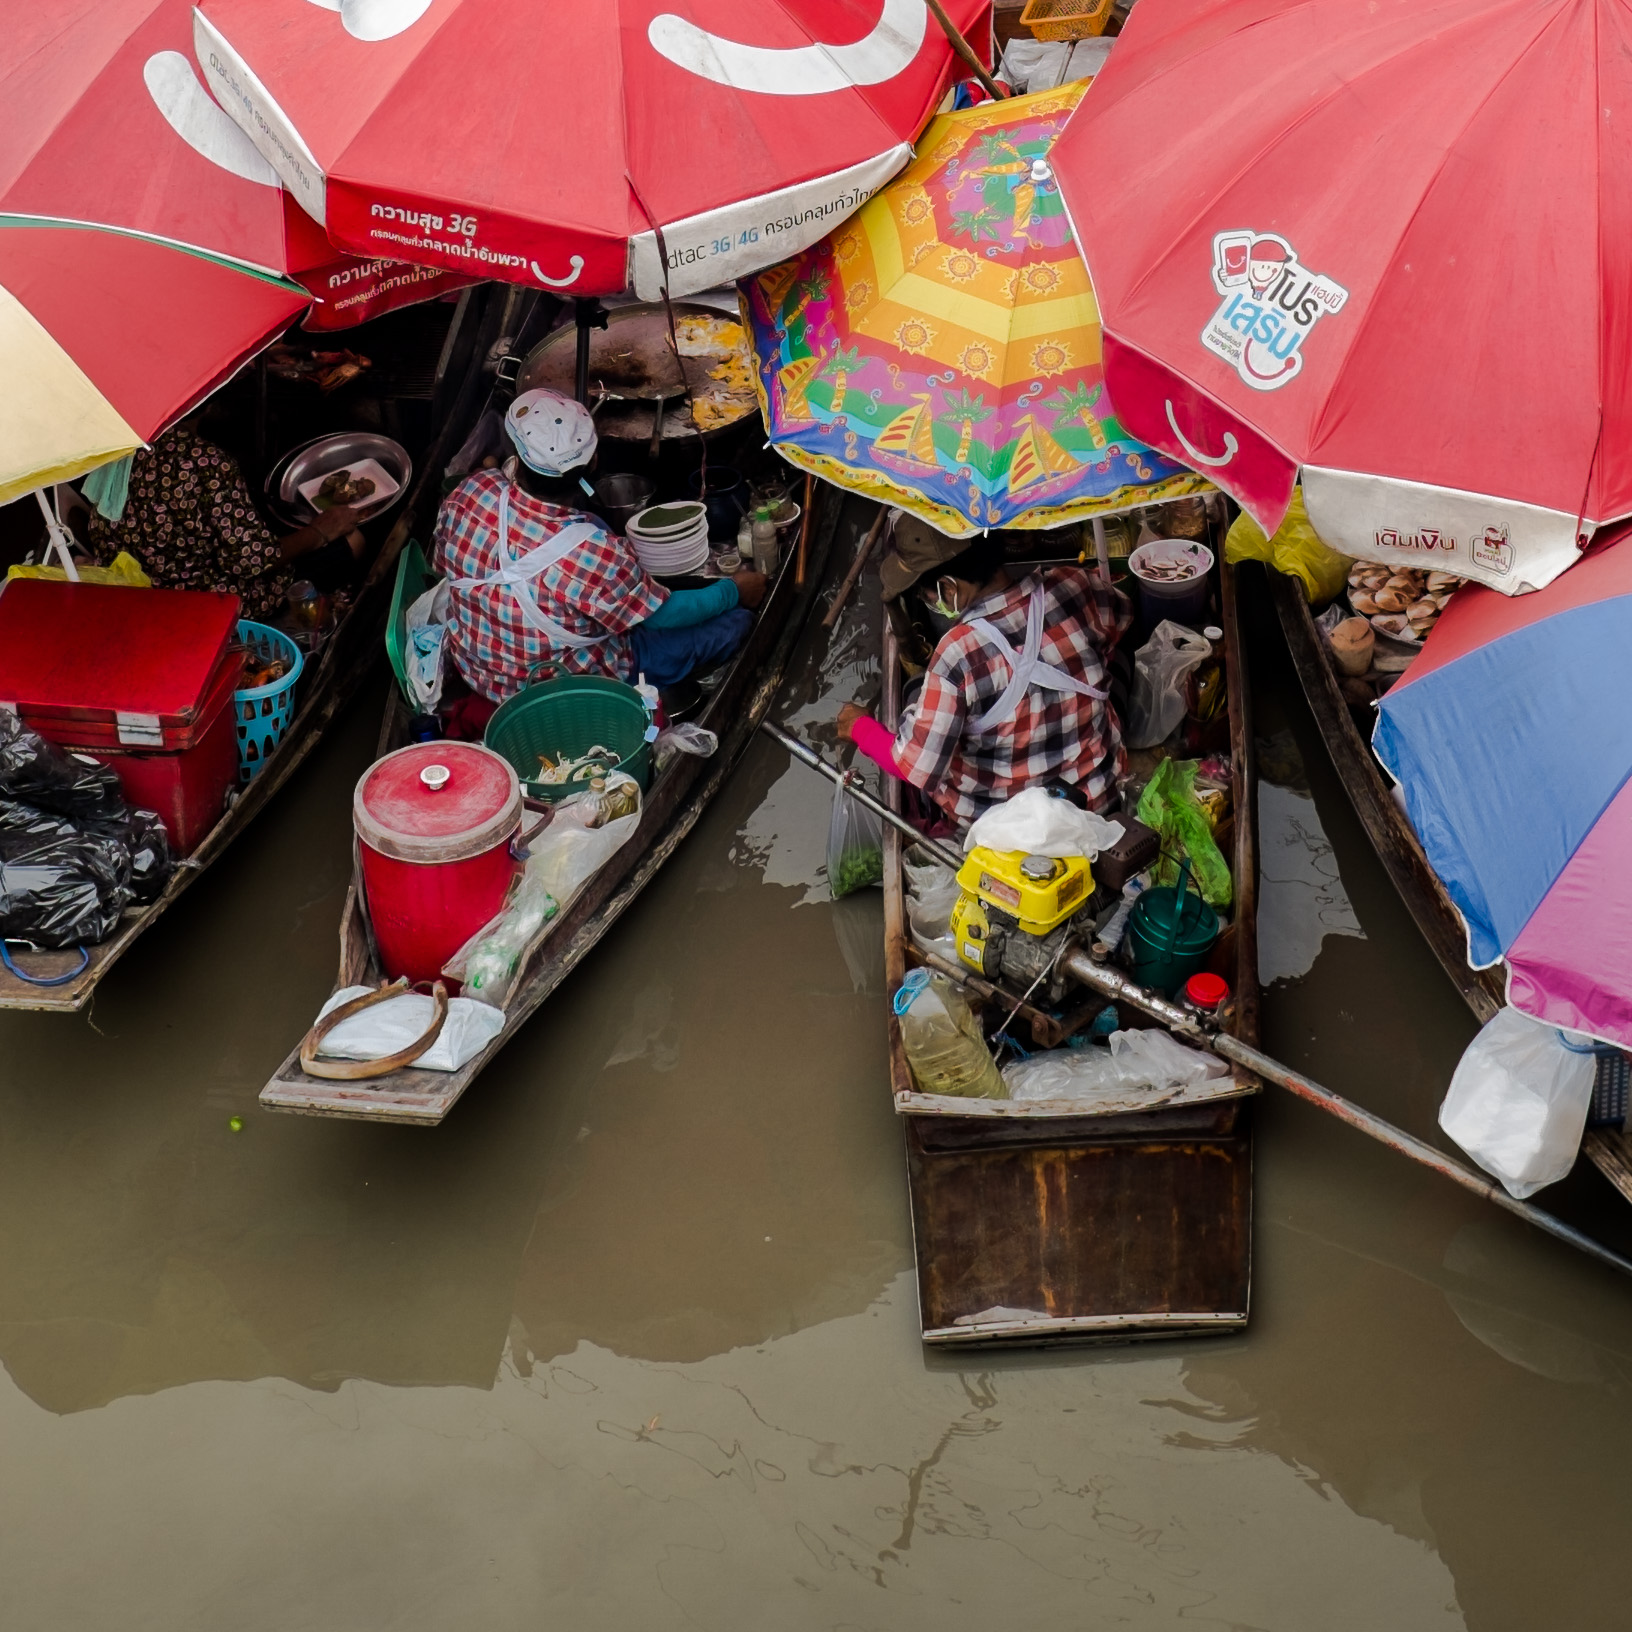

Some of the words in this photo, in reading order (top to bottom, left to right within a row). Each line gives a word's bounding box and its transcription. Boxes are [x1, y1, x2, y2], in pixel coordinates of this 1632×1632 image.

[371, 203, 444, 235] ความสุข
[447, 213, 477, 237] 3G
[667, 244, 707, 270] dtac
[710, 236, 731, 256] 3G
[737, 227, 760, 246] 4G
[1267, 267, 1319, 326] โปร
[1222, 292, 1301, 360] เสริม
[1375, 528, 1456, 551] เติมเงิน
